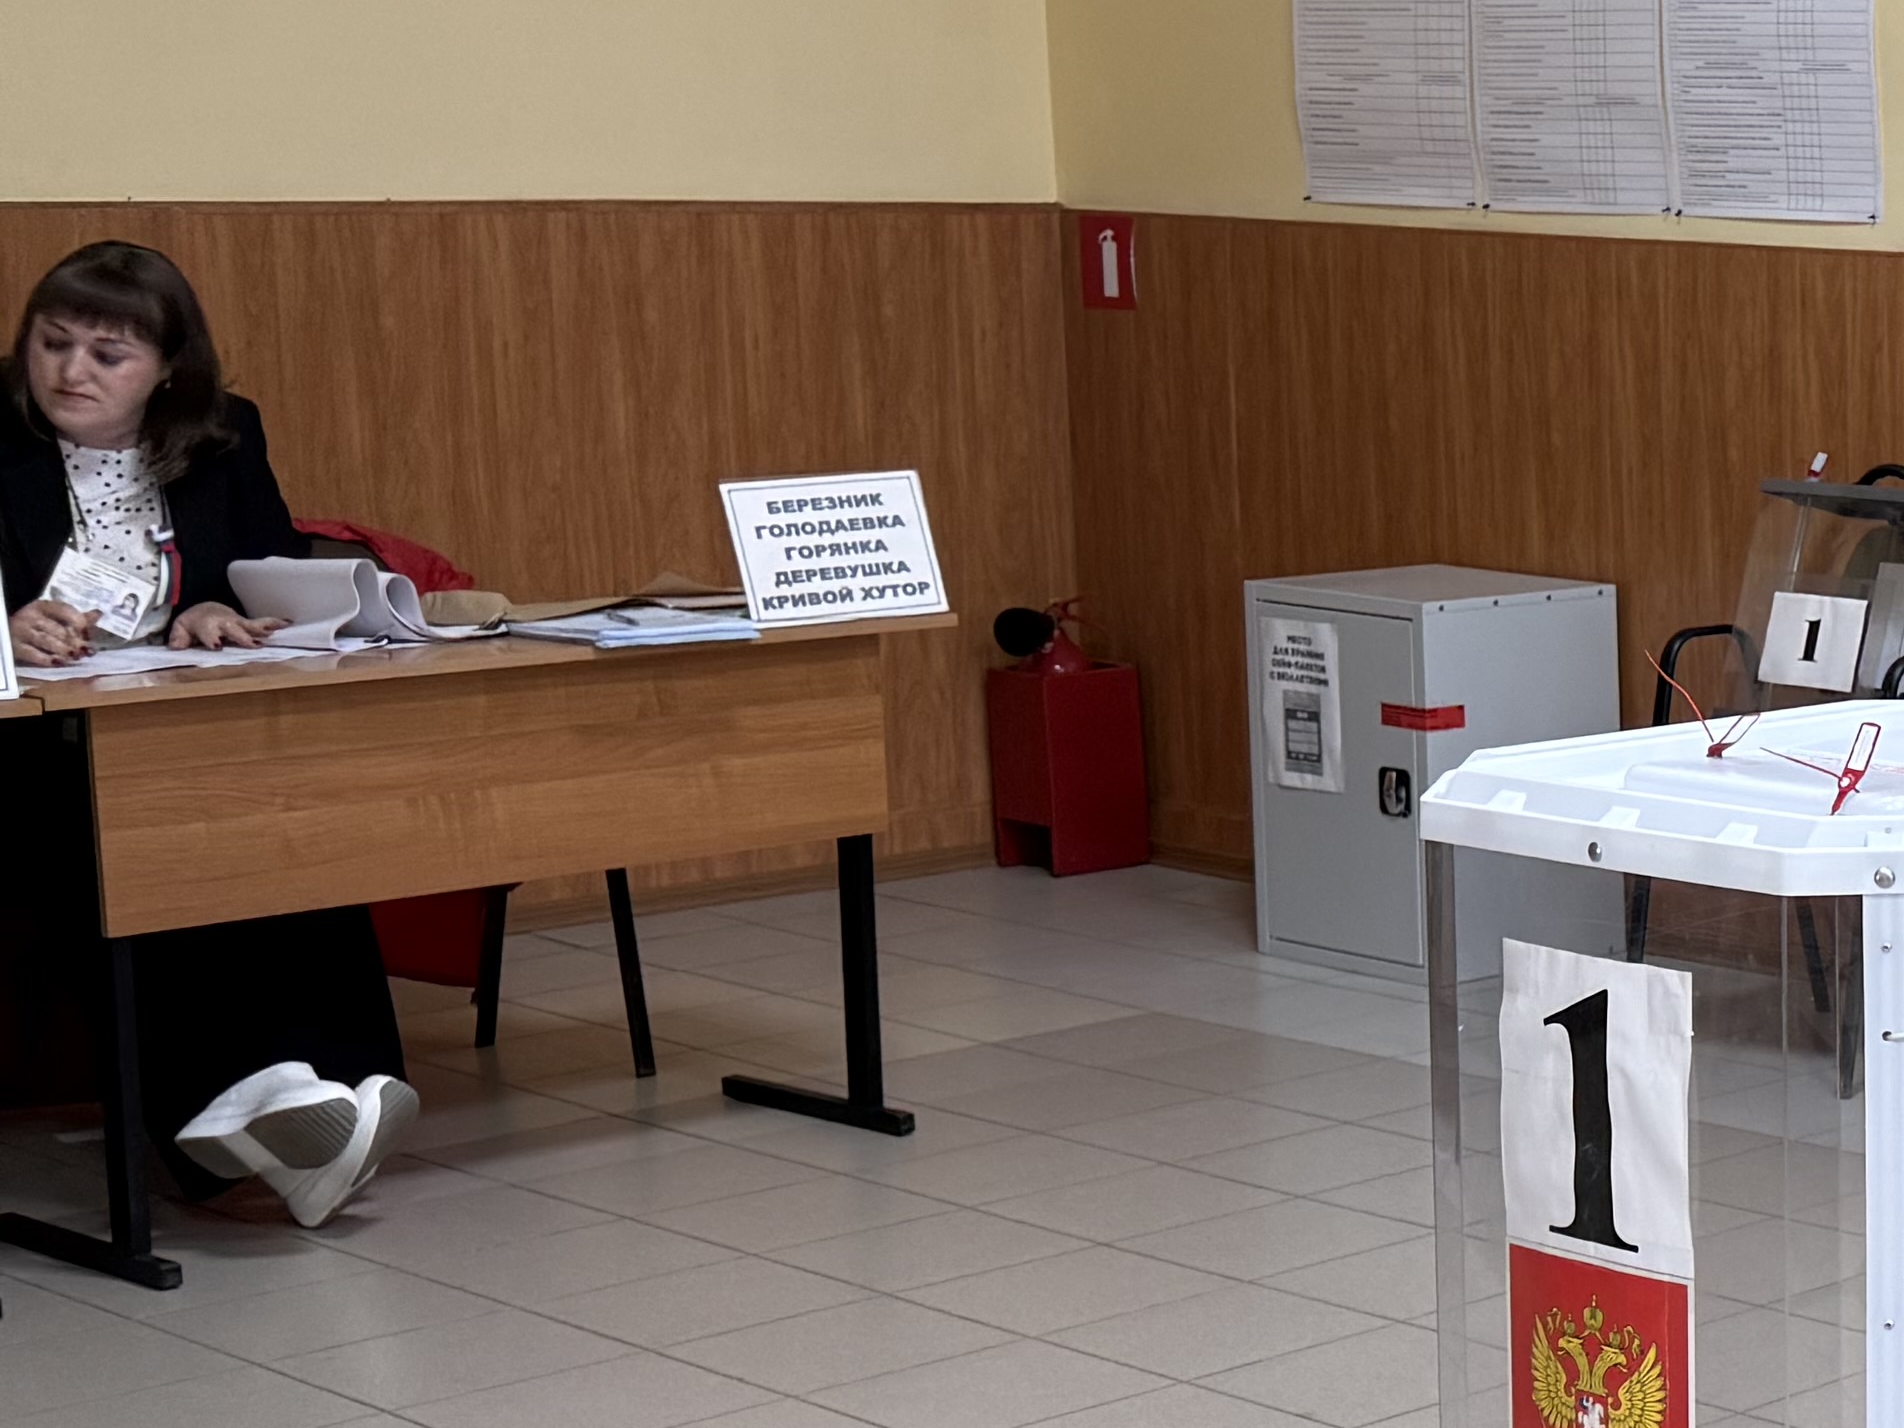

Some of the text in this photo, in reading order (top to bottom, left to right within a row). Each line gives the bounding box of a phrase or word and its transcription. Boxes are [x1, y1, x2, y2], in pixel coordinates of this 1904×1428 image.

[766, 492, 883, 515] БЕРЕЗНИК
[754, 514, 906, 540] ГОЛОДАЕВКА
[784, 538, 889, 561] ГОРЯНКА
[774, 560, 911, 587] ДЕРЕВУШКА
[762, 581, 931, 611] КРИВОЙ ХУТОР
[1797, 619, 1821, 663] 1
[1543, 987, 1639, 1254] 1
